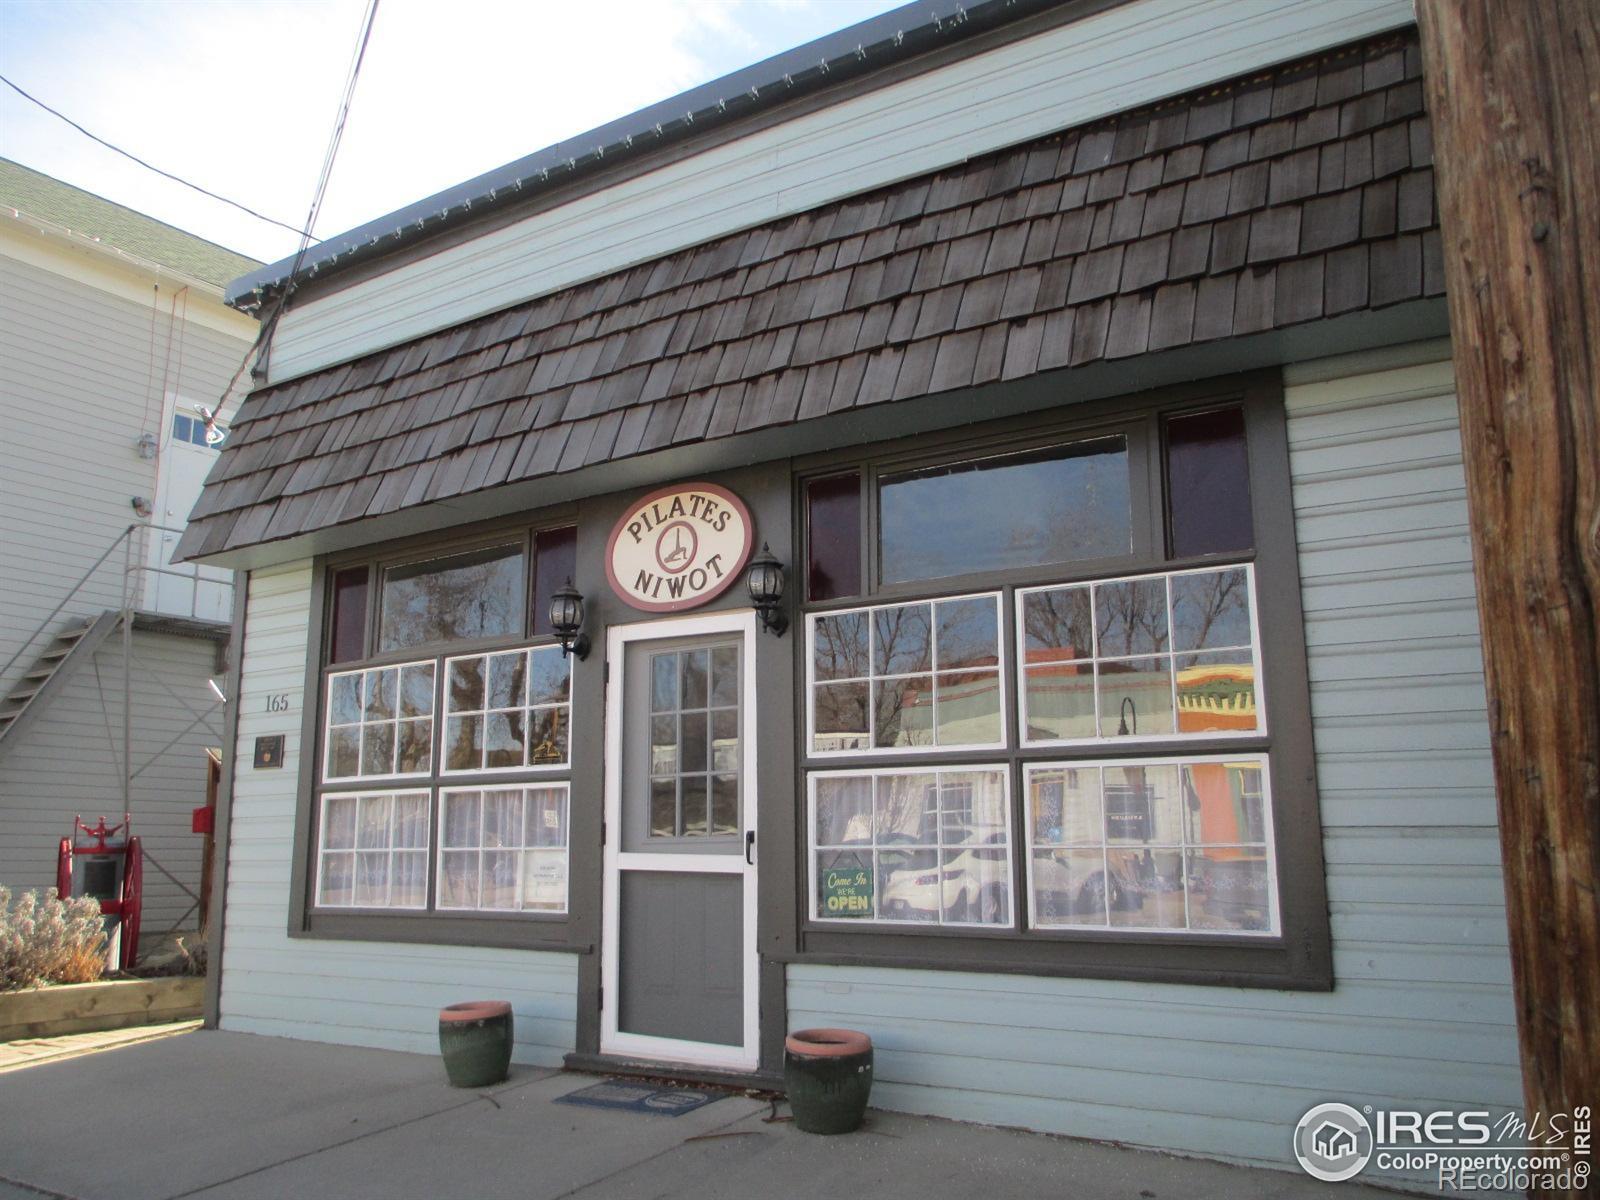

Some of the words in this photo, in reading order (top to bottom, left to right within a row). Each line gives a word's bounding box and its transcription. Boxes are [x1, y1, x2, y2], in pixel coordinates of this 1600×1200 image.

[627, 494, 731, 544] PILATES
[634, 554, 722, 599] NIWOT
[265, 694, 288, 712] 165
[828, 872, 852, 888] Come
[854, 872, 867, 886] In
[828, 895, 868, 911] OPEN
